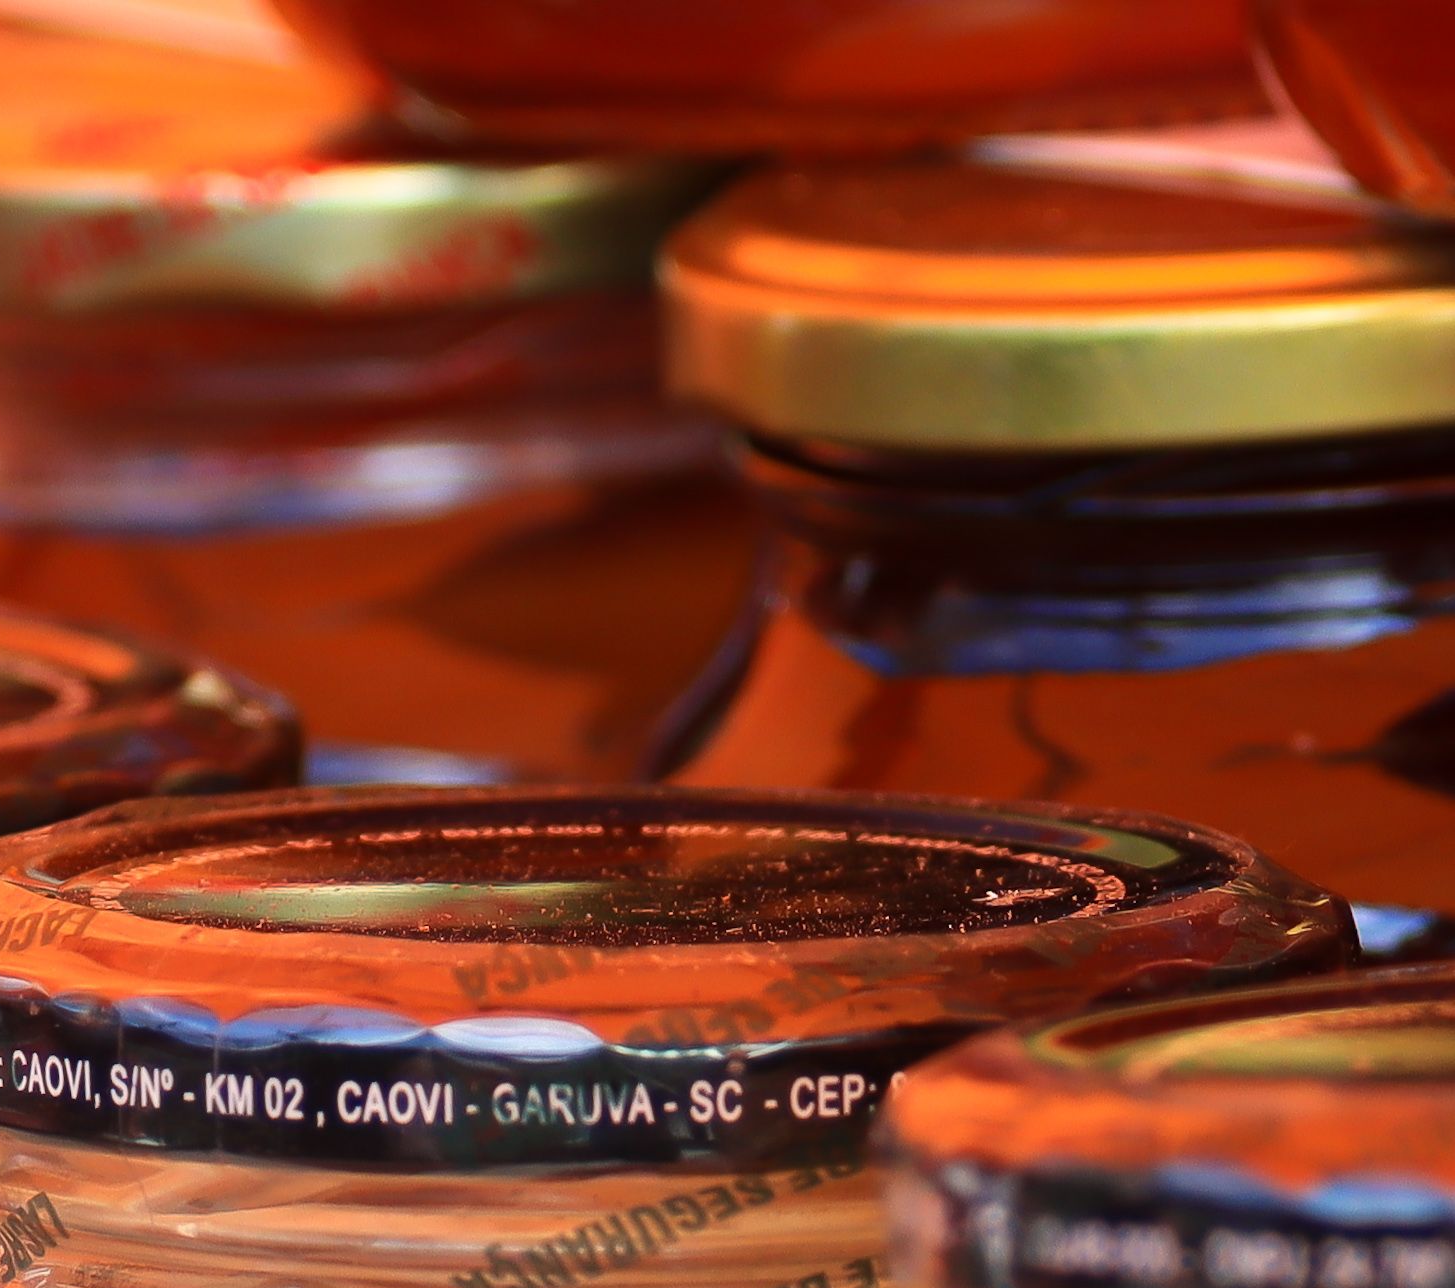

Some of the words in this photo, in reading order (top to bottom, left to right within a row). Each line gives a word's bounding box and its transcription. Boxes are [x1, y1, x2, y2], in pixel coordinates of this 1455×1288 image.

[12, 1049, 101, 1109] CAOVI,
[205, 1073, 254, 1117] KM
[264, 1077, 304, 1120] 02
[338, 1079, 453, 1126] CAOVI
[492, 1081, 655, 1126] GARUVA
[690, 1079, 742, 1123] SC
[790, 1073, 877, 1119] CEP:
